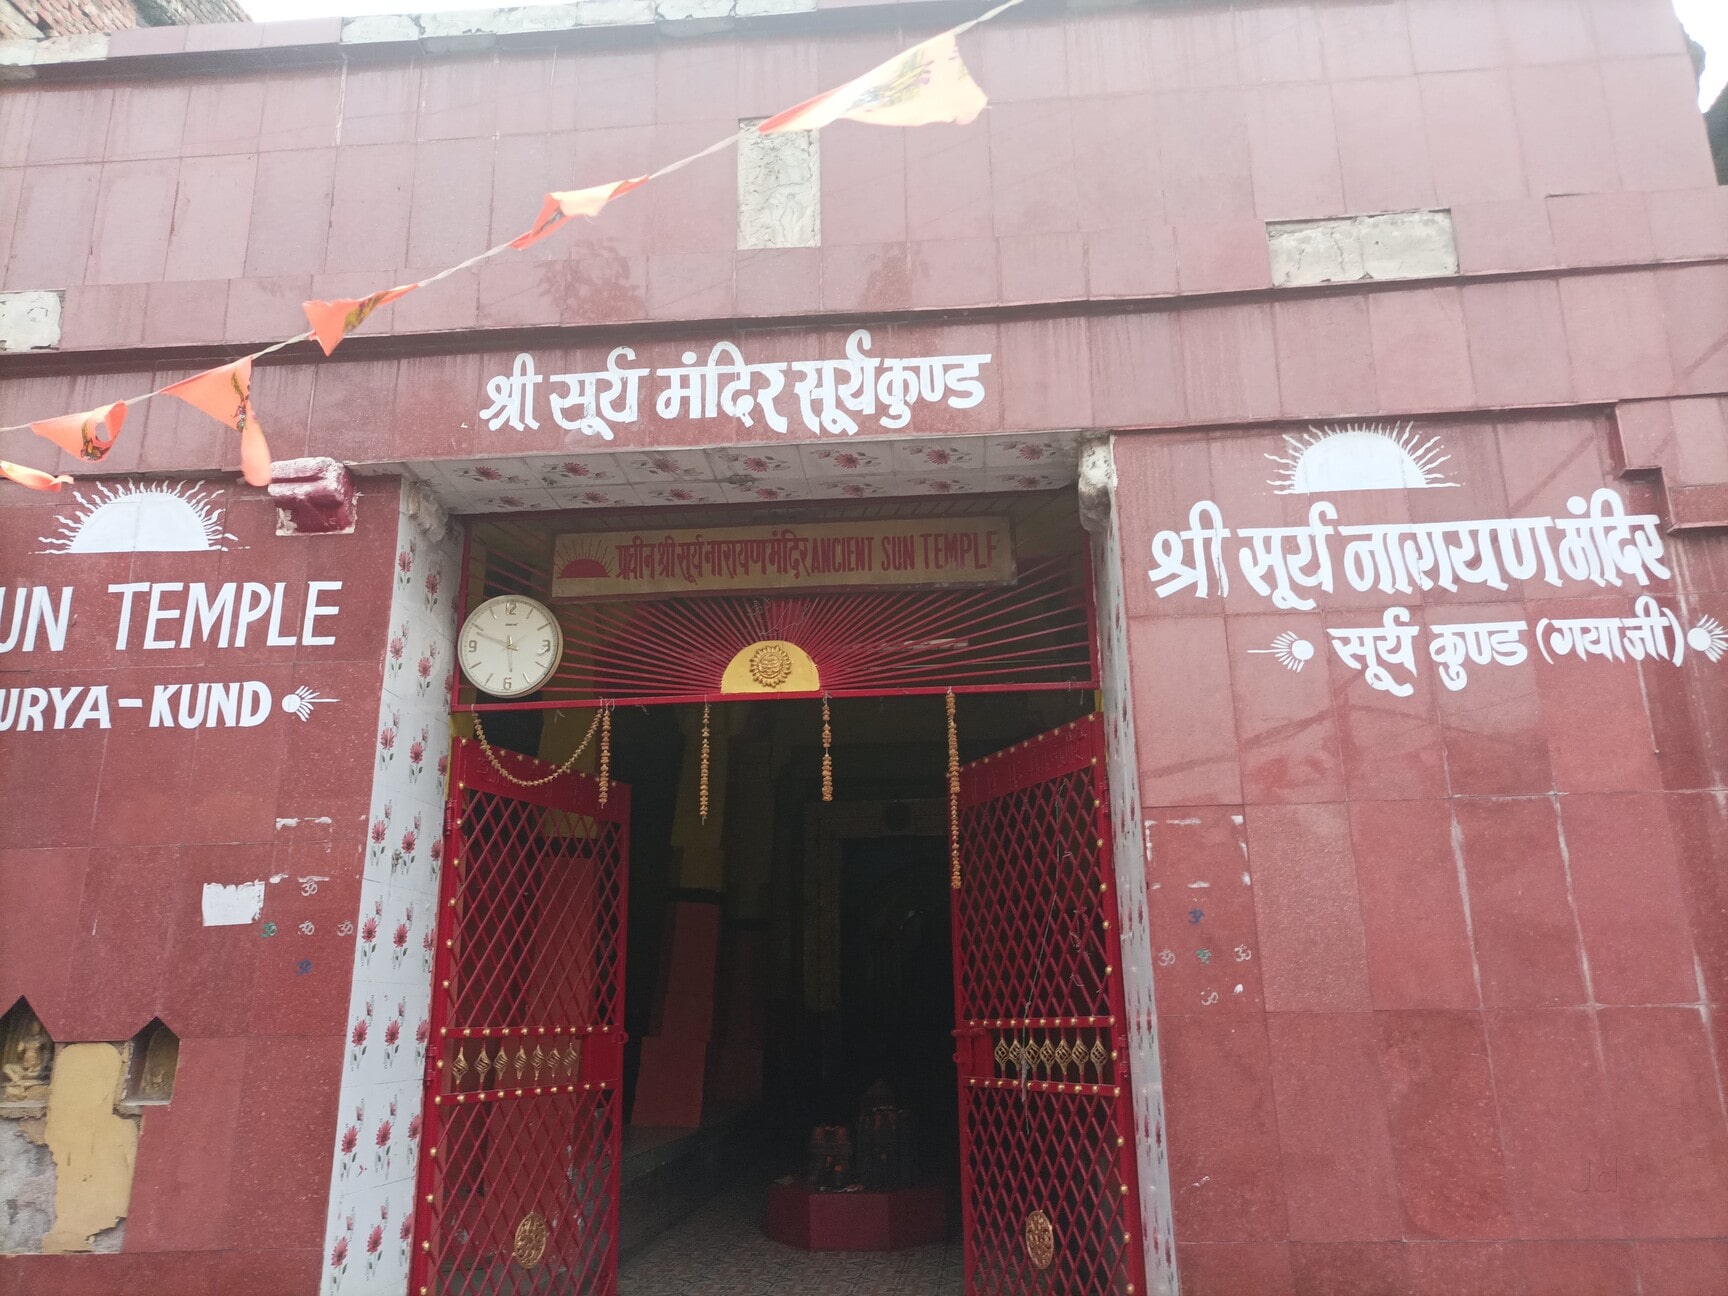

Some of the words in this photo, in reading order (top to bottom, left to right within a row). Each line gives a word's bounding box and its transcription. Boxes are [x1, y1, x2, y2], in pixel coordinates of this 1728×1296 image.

[479, 352, 544, 431] श्री
[549, 346, 651, 441] सूर्य
[656, 341, 788, 434] मंदिर
[811, 536, 875, 574] ANCIENT
[881, 535, 915, 571] SUN
[1147, 500, 1231, 599] श्री
[1237, 501, 1338, 610] सूर्य
[1338, 516, 1563, 595] नारायण
[1555, 488, 1672, 588] मंदिर
[108, 581, 343, 650] TEMPLE
[505, 602, 517, 615] 12
[468, 640, 477, 653] 9
[1326, 607, 1420, 697] सूर्य
[1429, 621, 1528, 691] कुण्ड
[503, 677, 512, 691] 6
